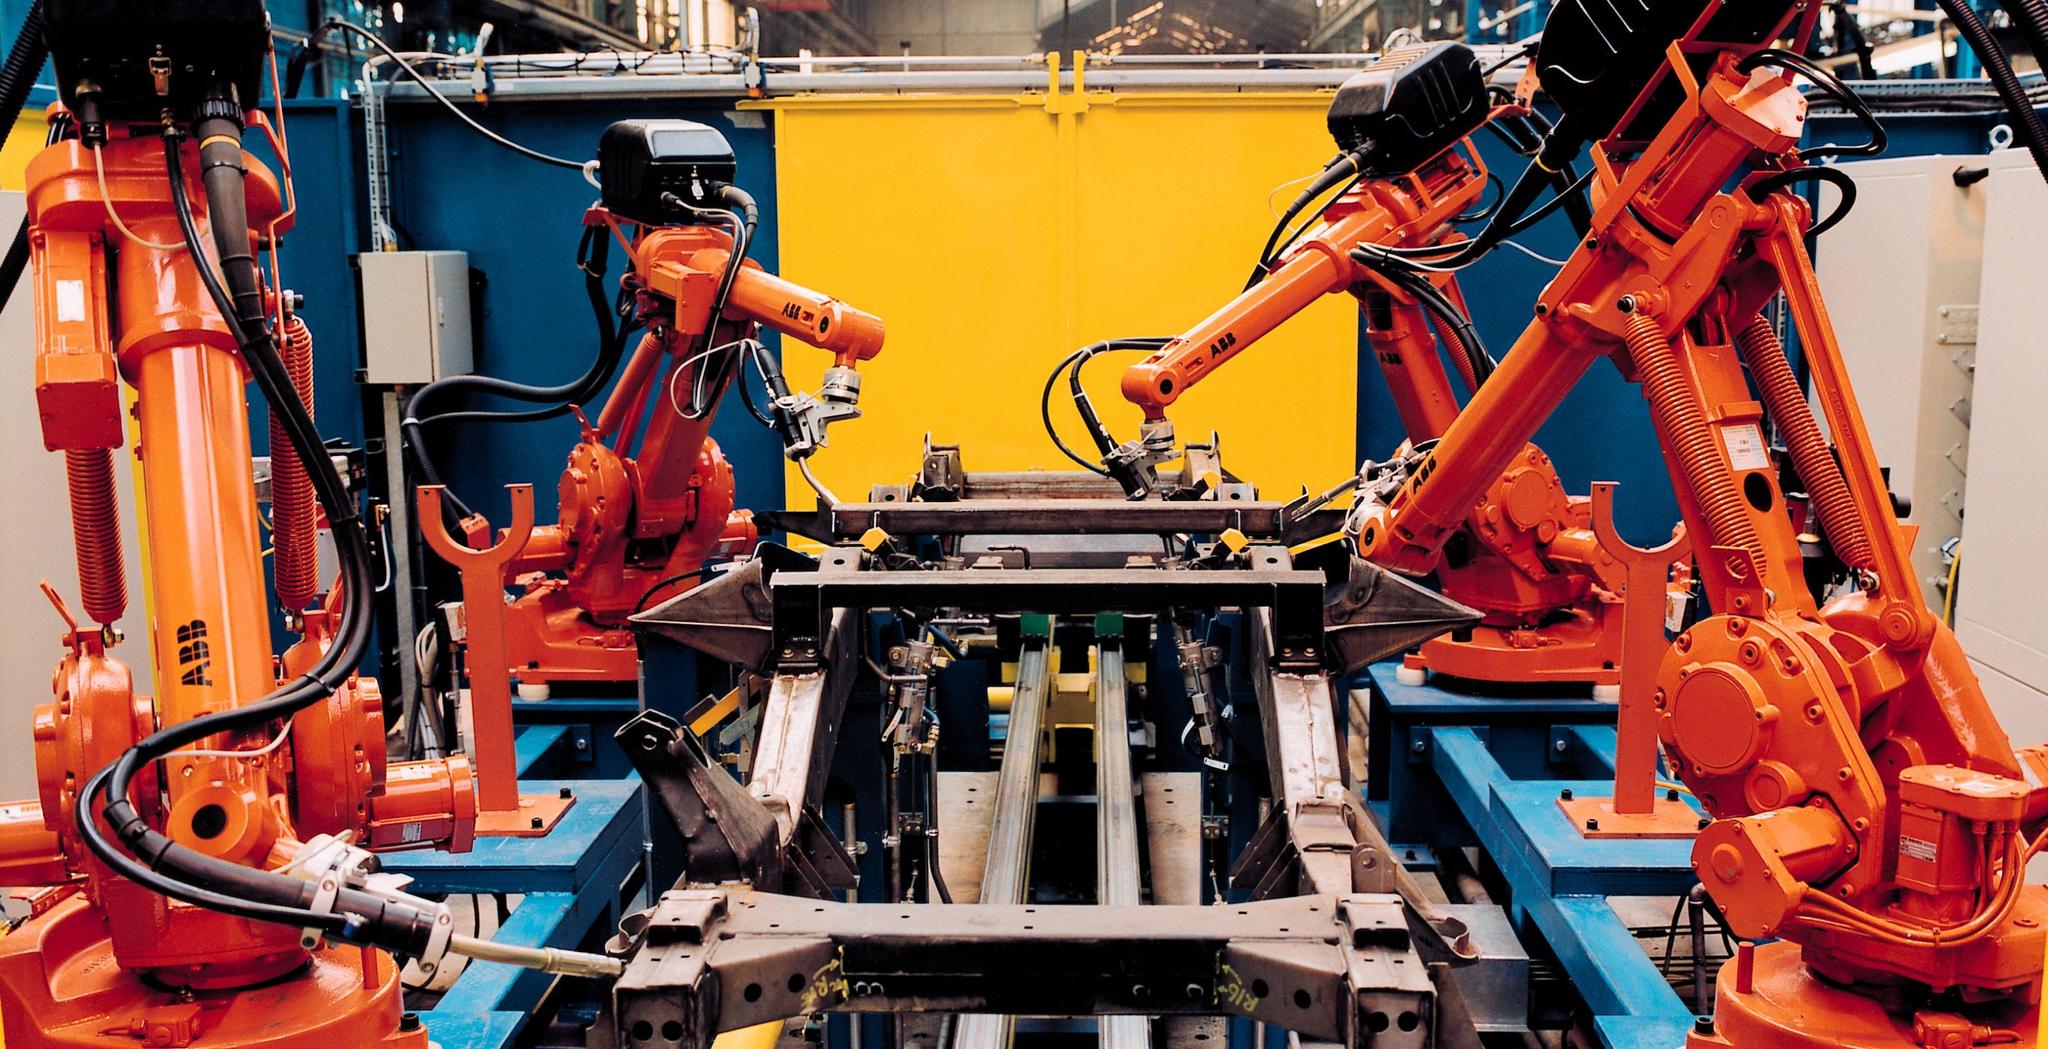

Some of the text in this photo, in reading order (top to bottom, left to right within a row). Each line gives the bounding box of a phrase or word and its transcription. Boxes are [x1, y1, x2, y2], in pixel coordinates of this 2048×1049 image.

[782, 301, 801, 320] ABB
[1210, 332, 1237, 359] ABB
[1379, 351, 1403, 365] ABB
[1413, 455, 1437, 496] ABB
[177, 619, 213, 687] ABB
